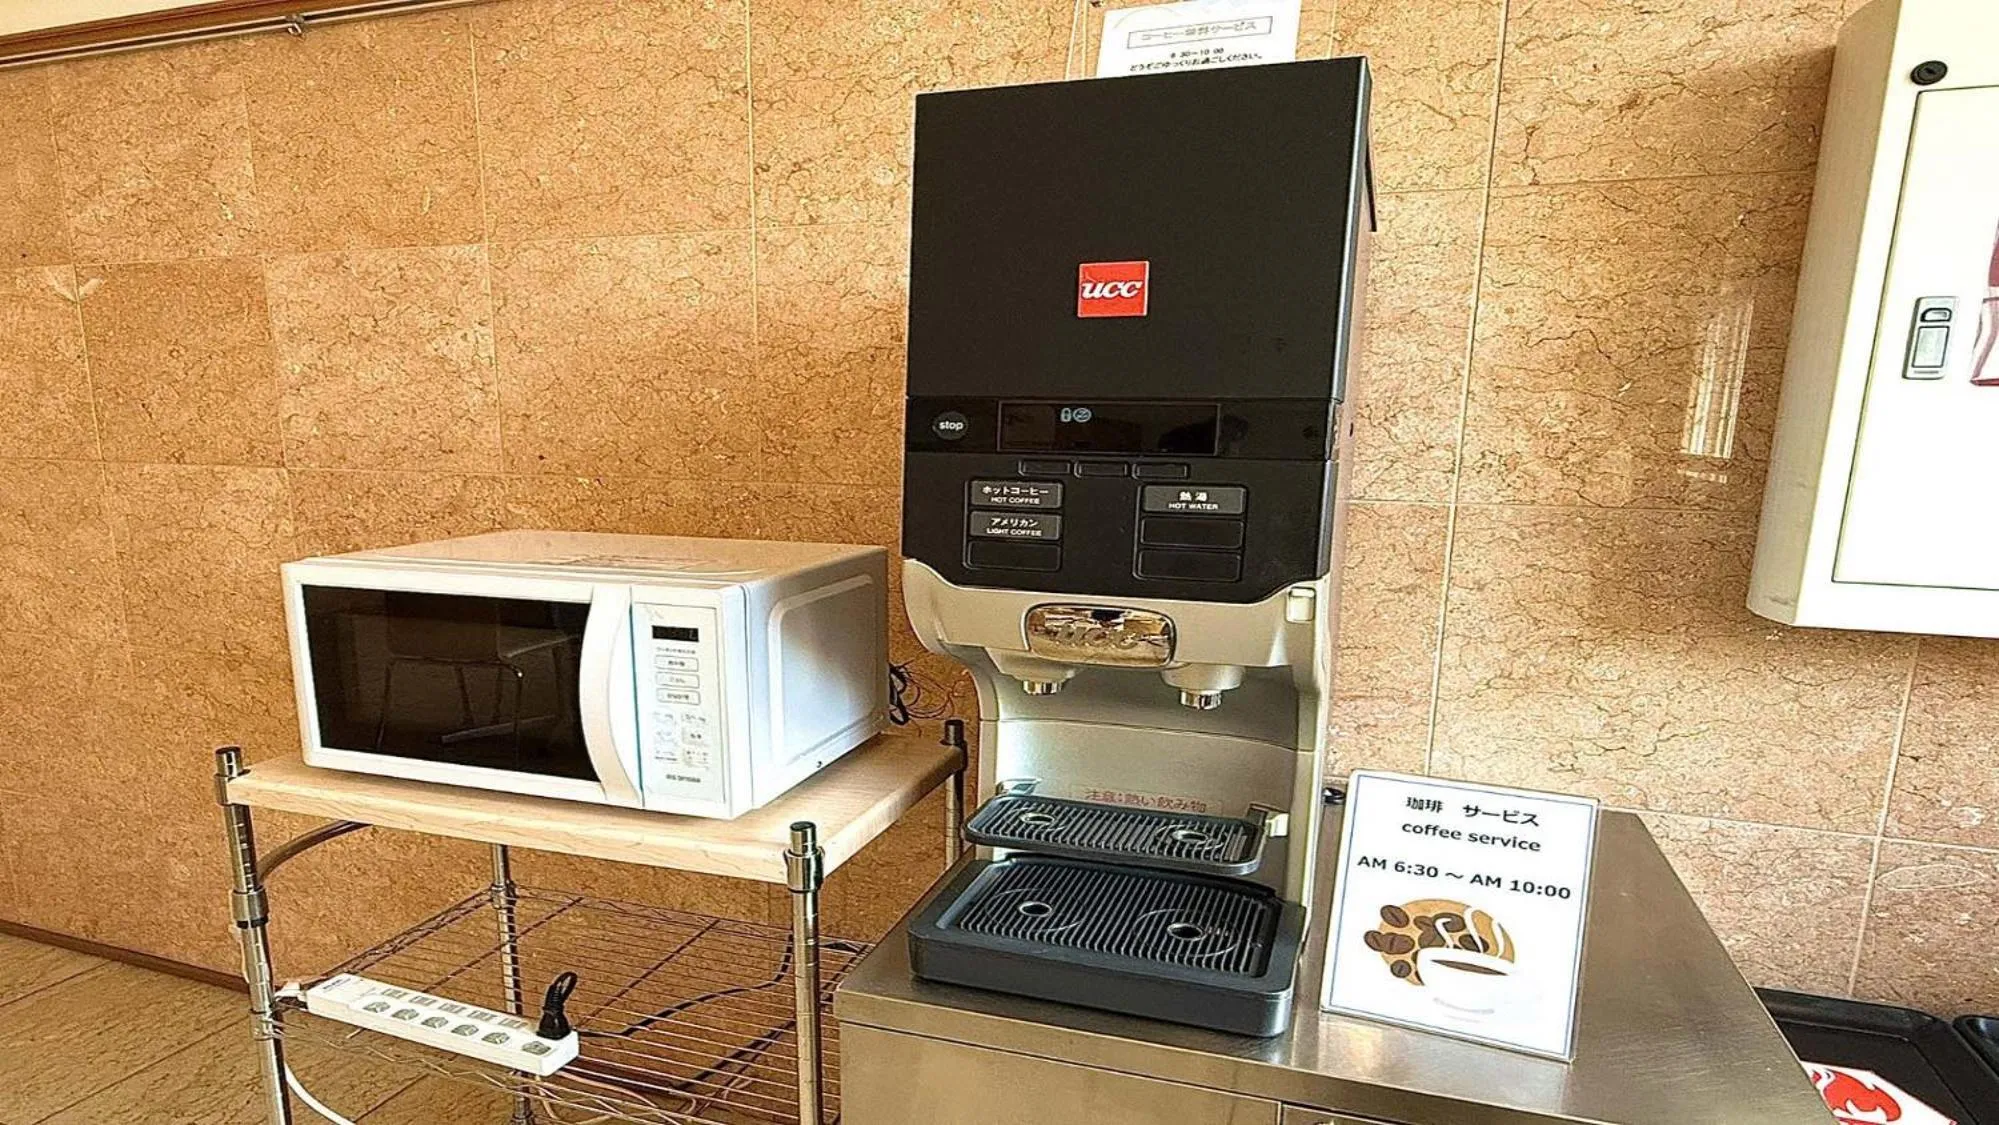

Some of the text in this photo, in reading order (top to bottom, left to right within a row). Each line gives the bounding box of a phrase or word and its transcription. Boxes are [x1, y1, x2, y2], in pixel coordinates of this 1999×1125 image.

[939, 420, 964, 432] stop
[982, 485, 1049, 496] ホットコーヒー
[1008, 496, 1041, 505] COFFEE
[991, 517, 1039, 527] アメリカン
[986, 527, 1042, 537] LIGHT COFFEE
[1406, 796, 1540, 827] 珈琲 サービス
[1402, 822, 1542, 852] coffee service
[1357, 855, 1387, 870] AM
[1394, 861, 1439, 878] 6:30
[1469, 873, 1502, 889] AM
[1509, 879, 1571, 900] 10:00
